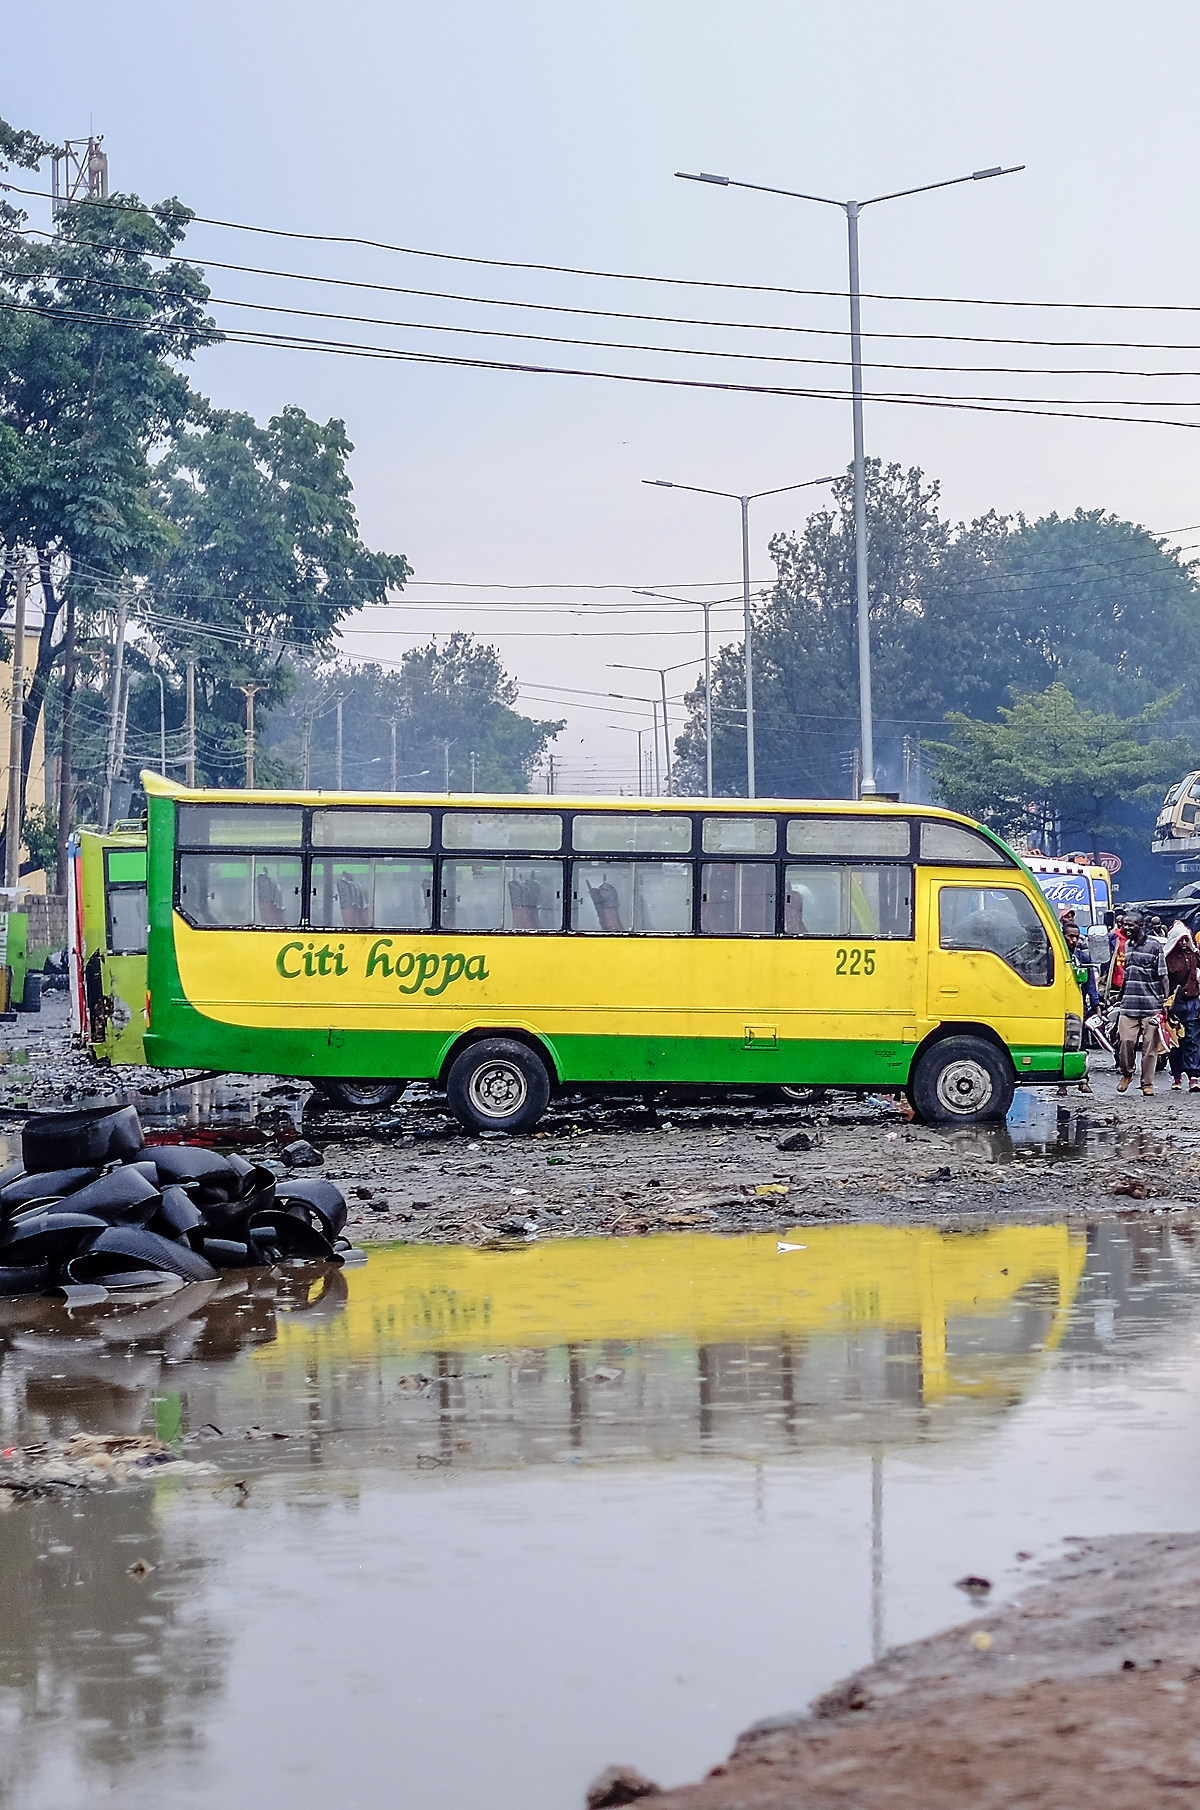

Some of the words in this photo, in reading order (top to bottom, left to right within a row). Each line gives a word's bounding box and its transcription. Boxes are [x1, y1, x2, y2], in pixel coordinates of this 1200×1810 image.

[276, 942, 348, 979] Citi
[365, 938, 490, 996] hoppa
[836, 949, 876, 975] 225
